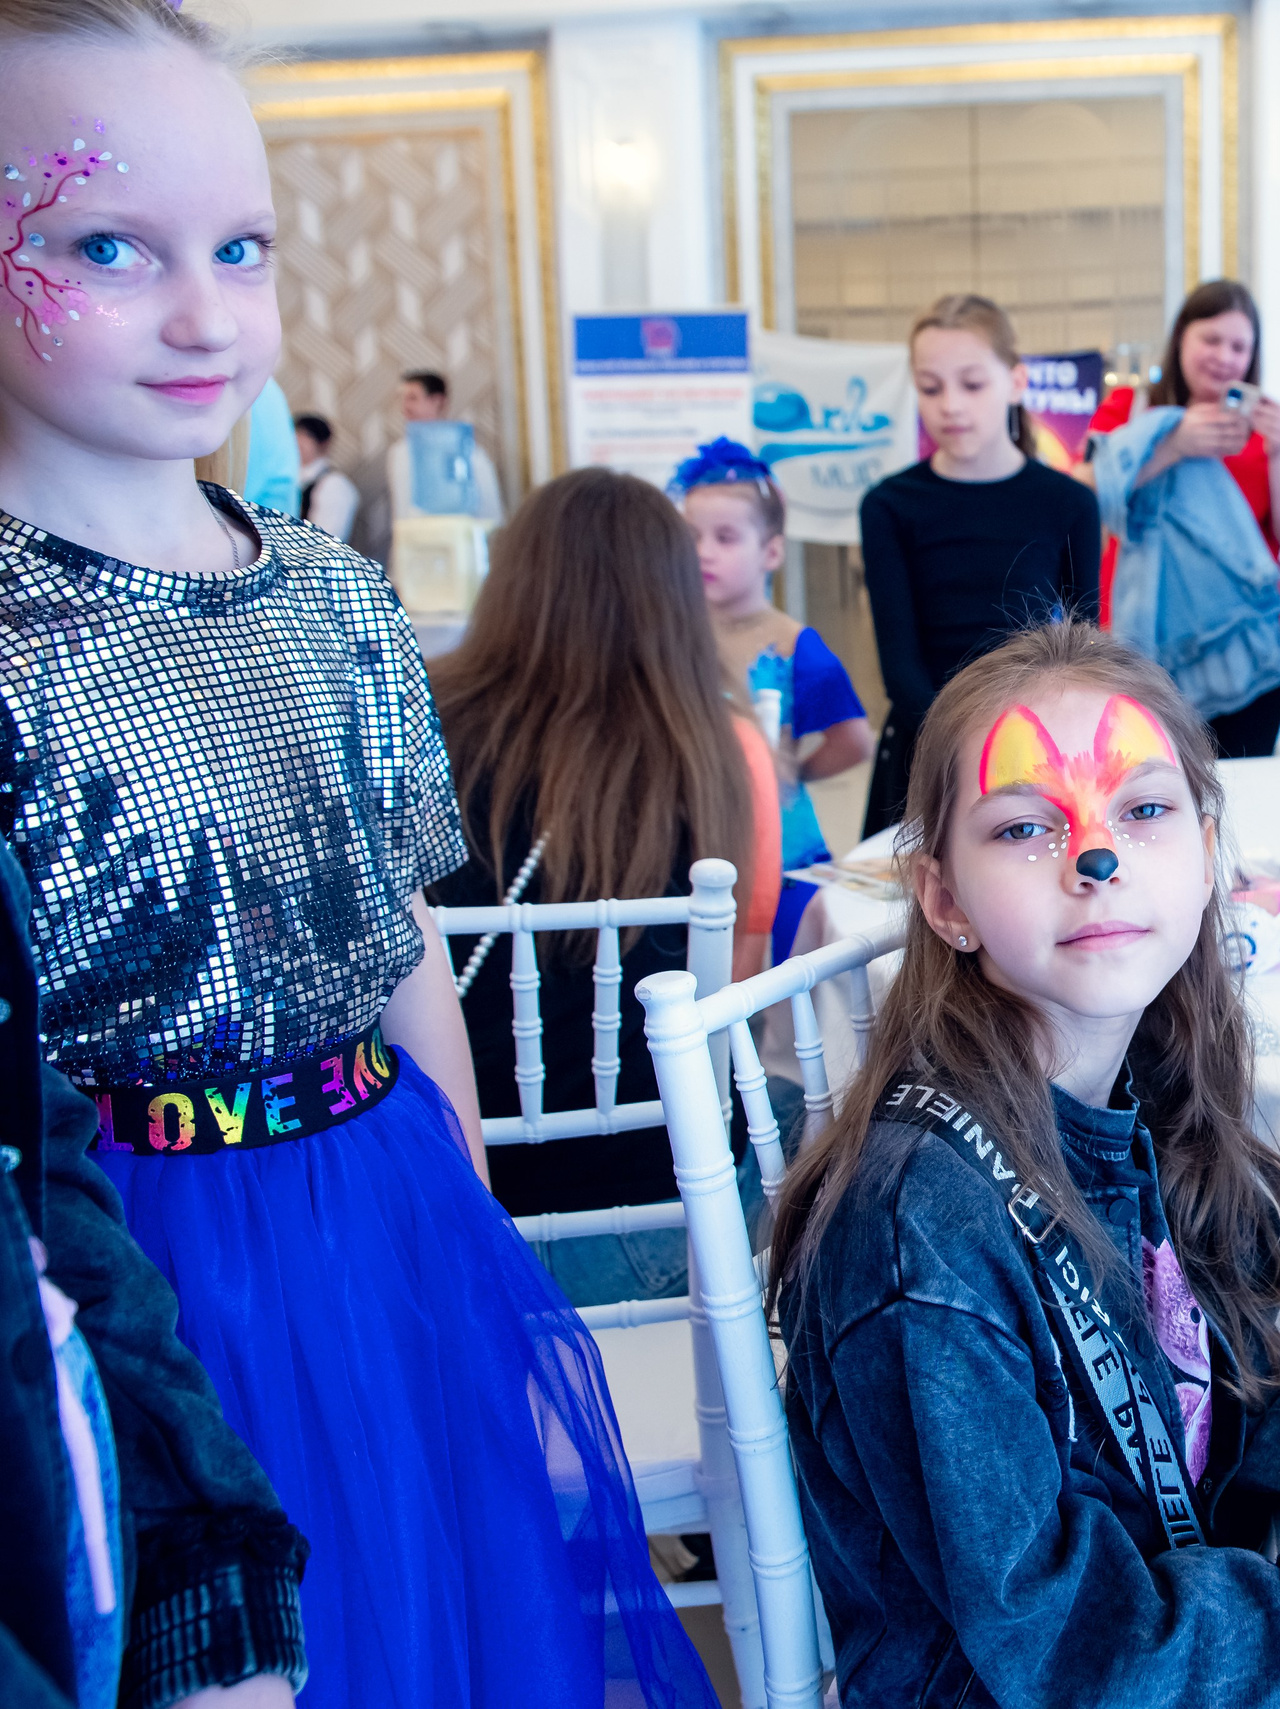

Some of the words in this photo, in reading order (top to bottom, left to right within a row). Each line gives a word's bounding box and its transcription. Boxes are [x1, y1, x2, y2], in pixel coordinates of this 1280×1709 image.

[95, 1072, 303, 1152] LOVE
[320, 1026, 391, 1117] OVE
[886, 1084, 1041, 1210] DANIELE
